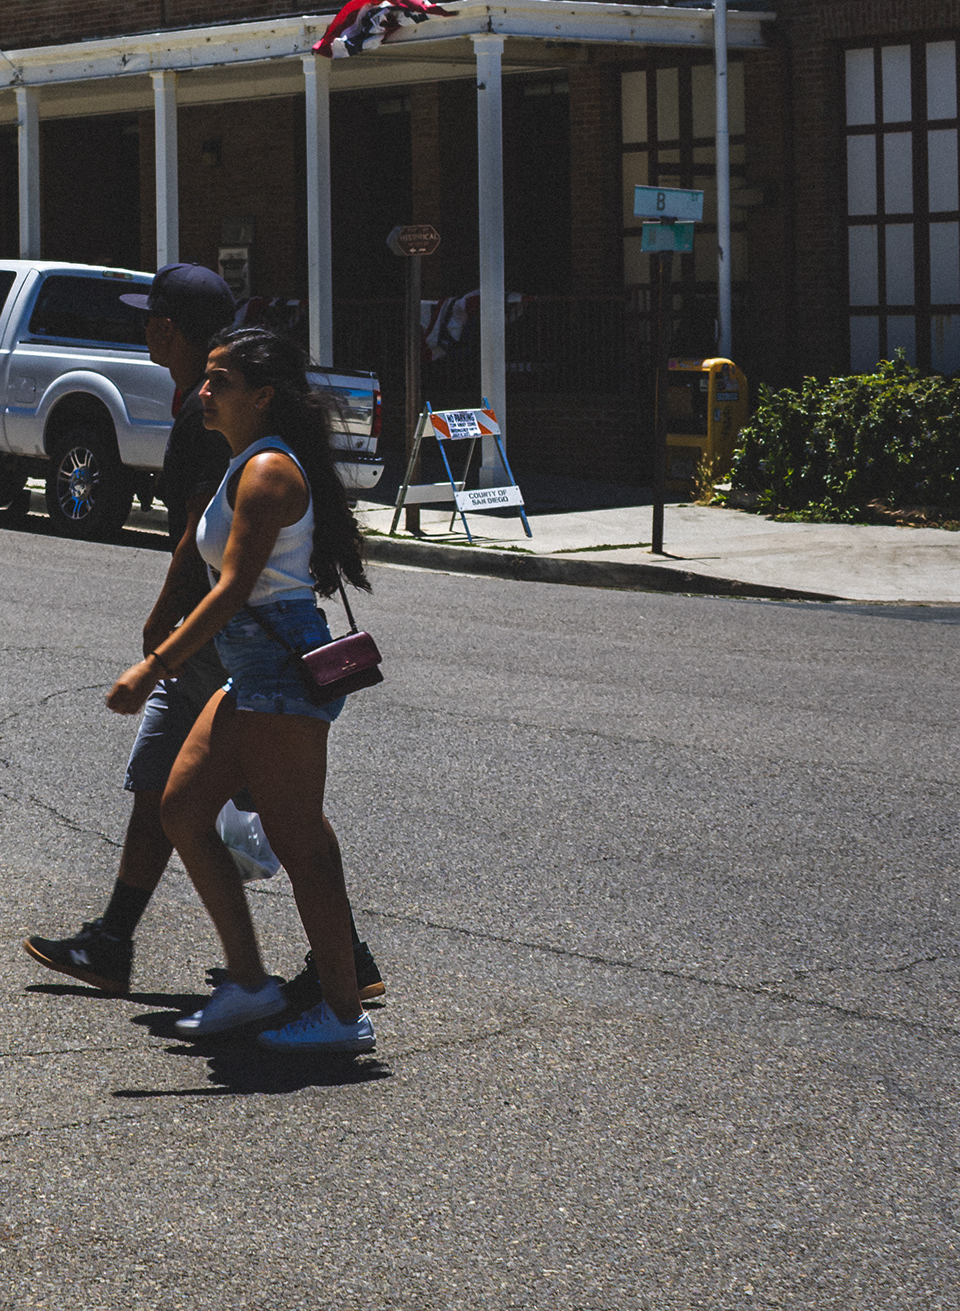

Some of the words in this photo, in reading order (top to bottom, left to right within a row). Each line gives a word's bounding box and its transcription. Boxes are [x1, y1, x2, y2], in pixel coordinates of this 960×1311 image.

[656, 192, 665, 211] B
[454, 412, 475, 423] PARKING
[468, 490, 496, 499] COUNTY
[487, 496, 509, 504] DIEGO
